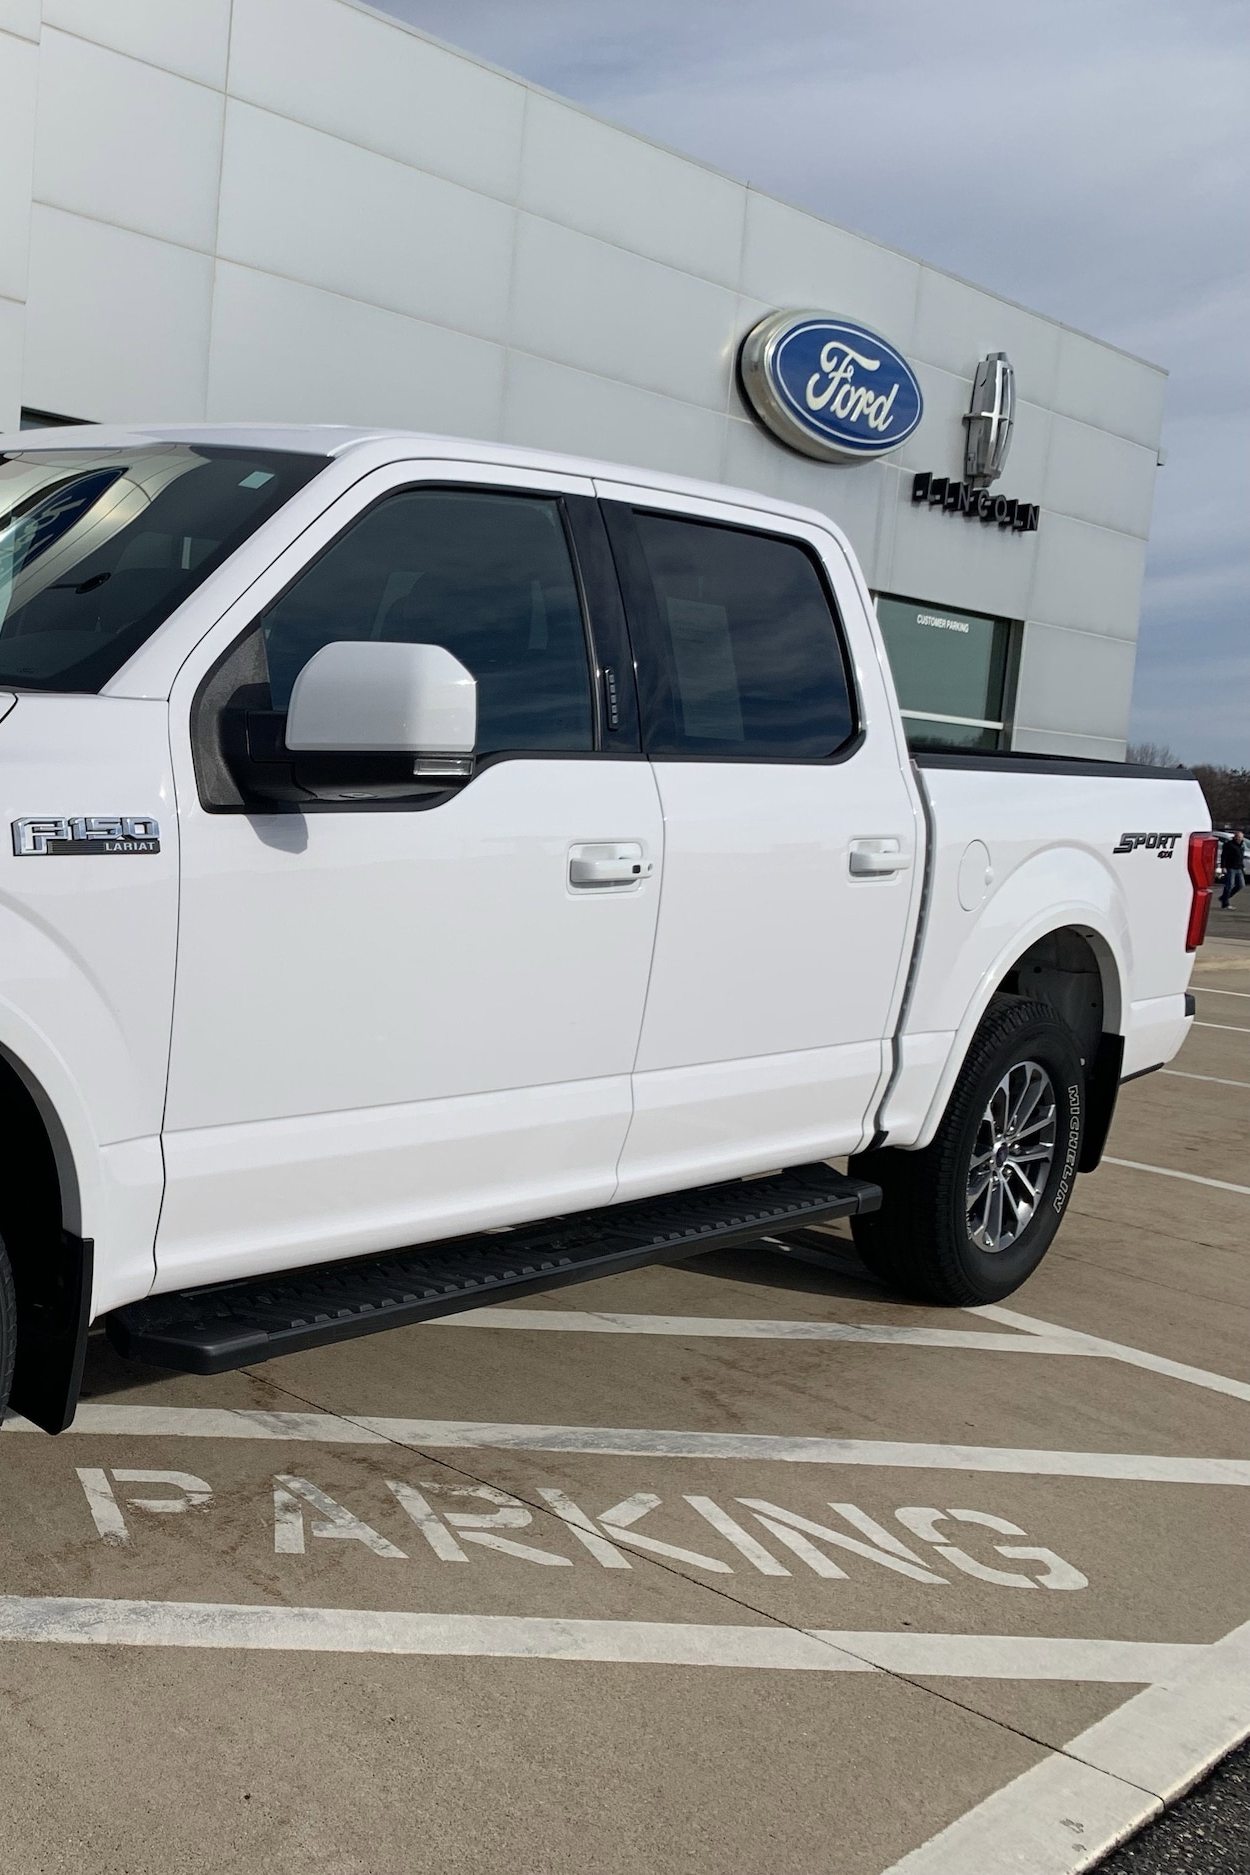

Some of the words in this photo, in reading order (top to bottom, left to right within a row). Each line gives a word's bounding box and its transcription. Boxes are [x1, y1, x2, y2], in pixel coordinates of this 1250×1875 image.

[806, 341, 899, 432] Ford
[917, 614, 946, 629] CUSTOMER
[946, 620, 969, 633] PARKING
[105, 841, 155, 851] LARIAT
[1113, 832, 1182, 854] SPORT
[1054, 1084, 1081, 1214] MICHELIN
[74, 1467, 1090, 1591] PARKING
